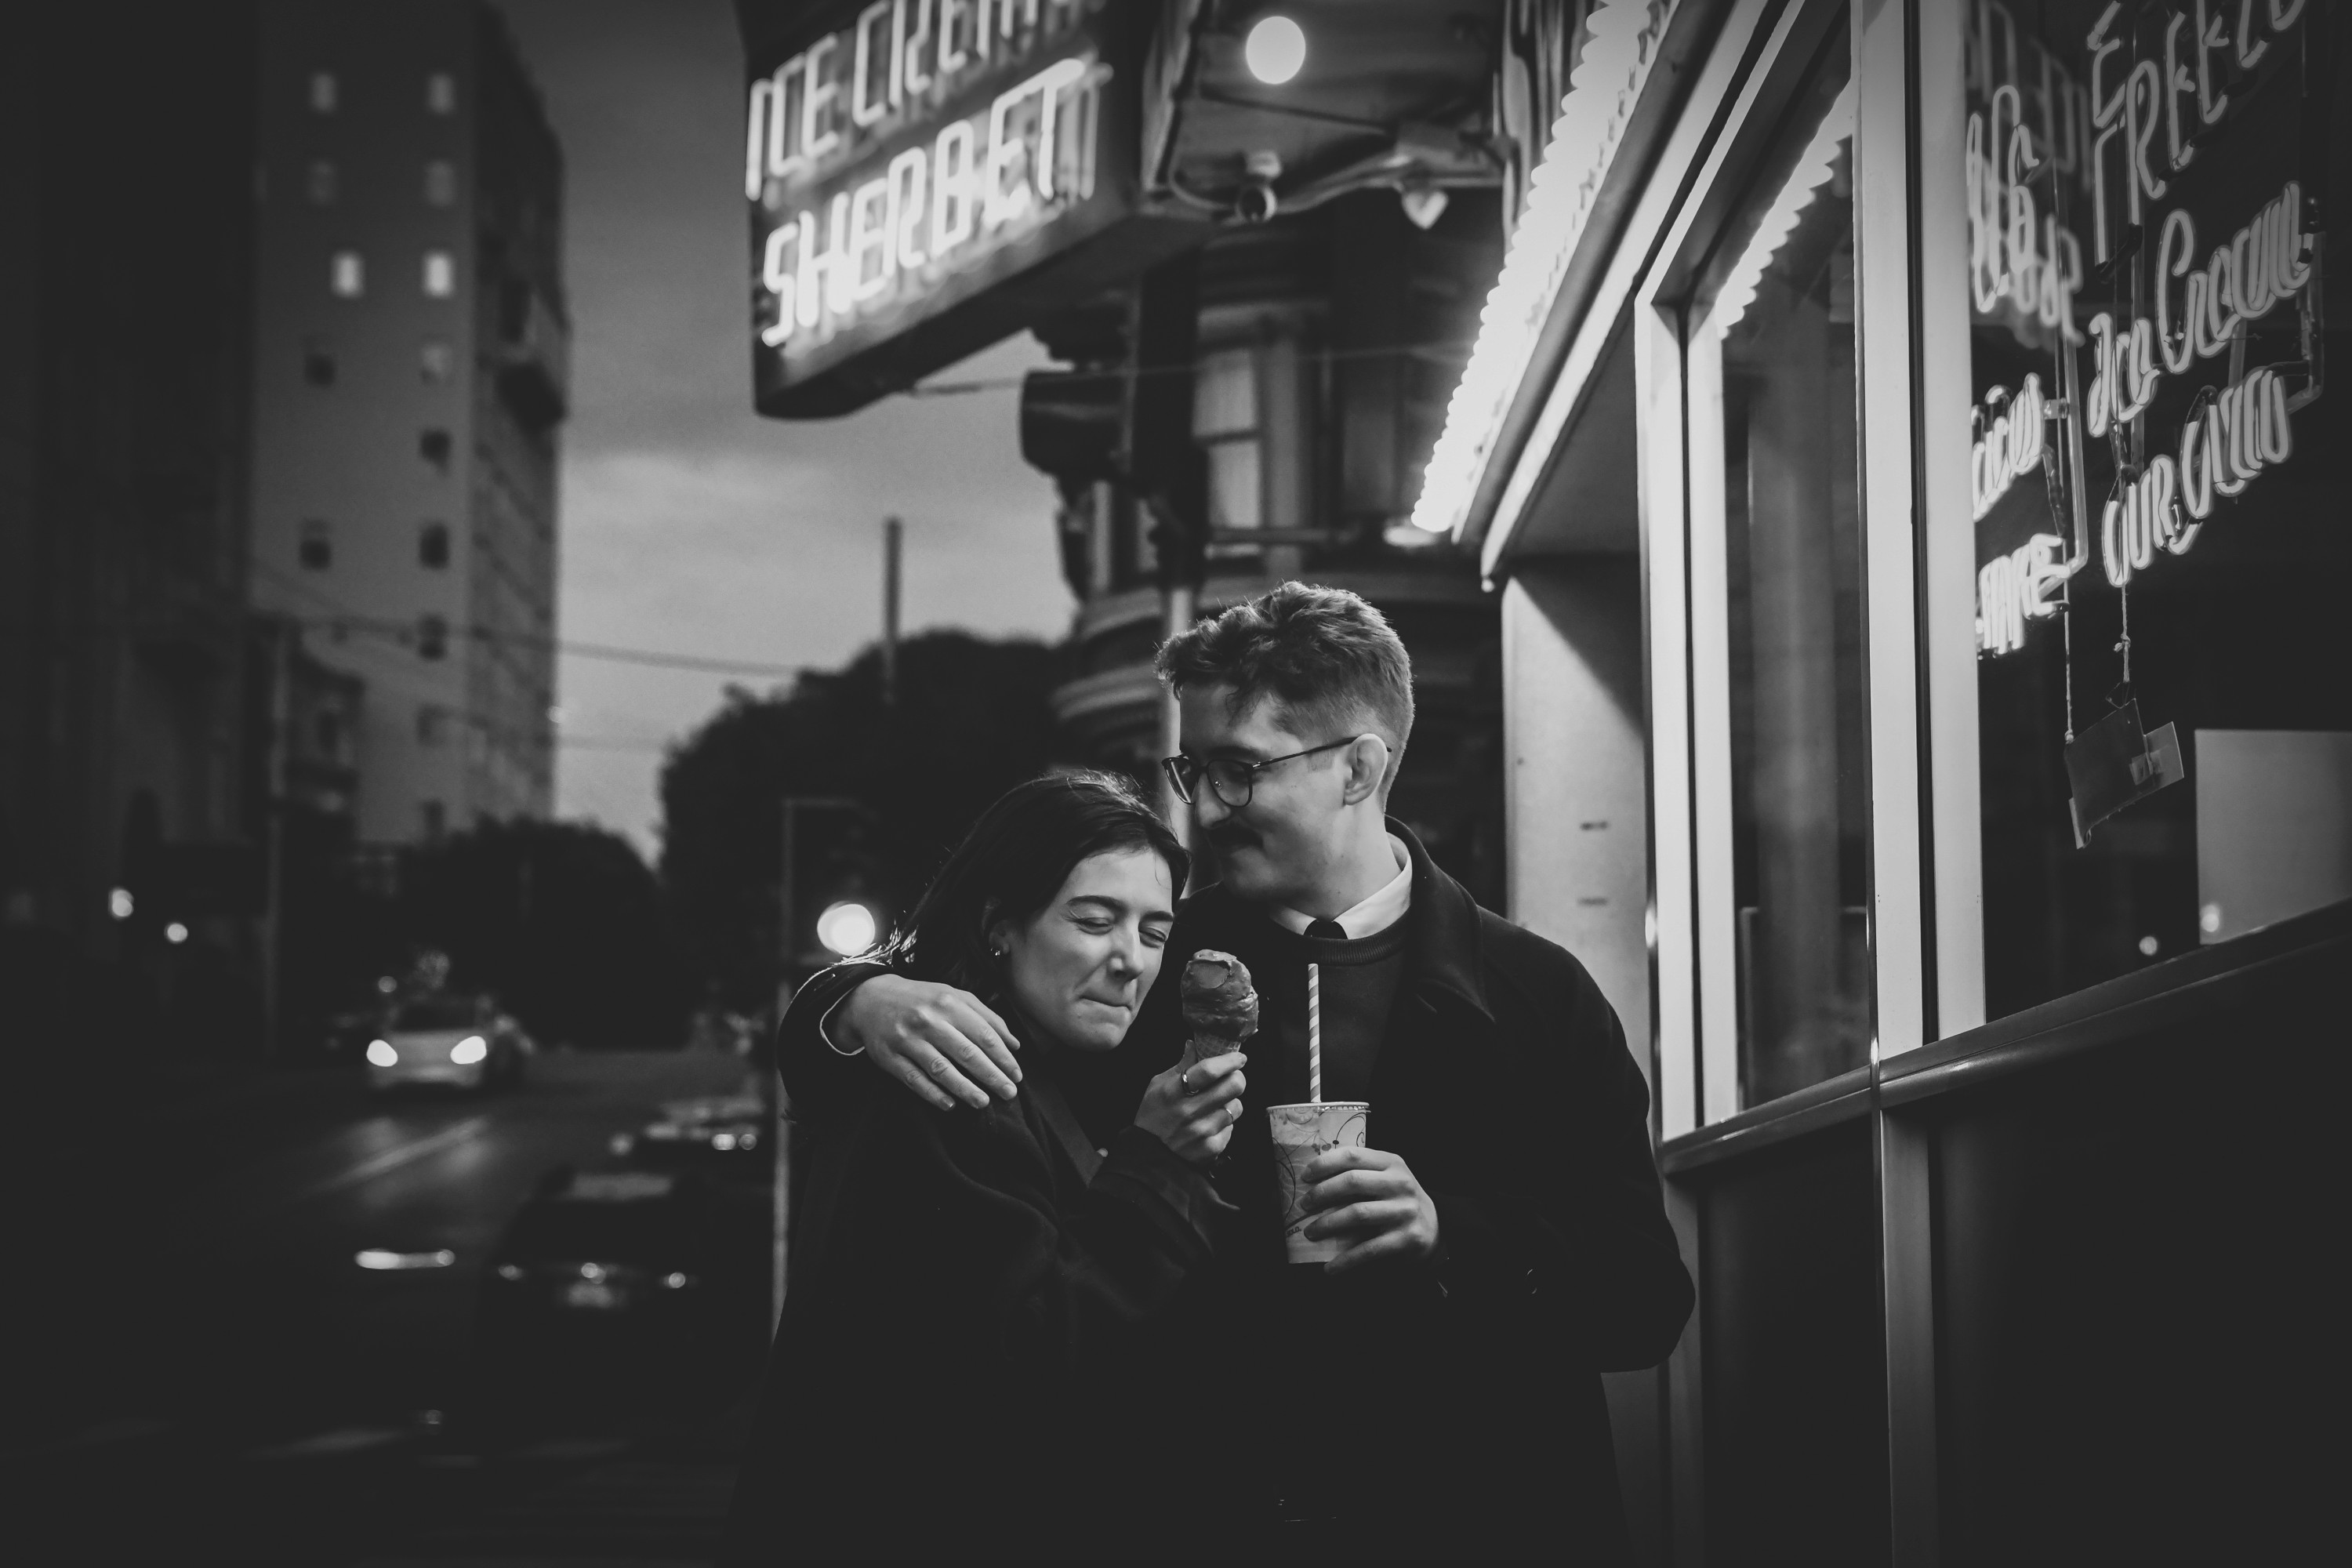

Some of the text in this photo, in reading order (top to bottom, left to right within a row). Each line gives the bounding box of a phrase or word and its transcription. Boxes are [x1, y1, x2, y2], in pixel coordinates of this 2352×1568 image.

[745, 31, 840, 201] ICE
[761, 58, 1086, 347] SHERBET
[2101, 454, 2203, 588] OUR
